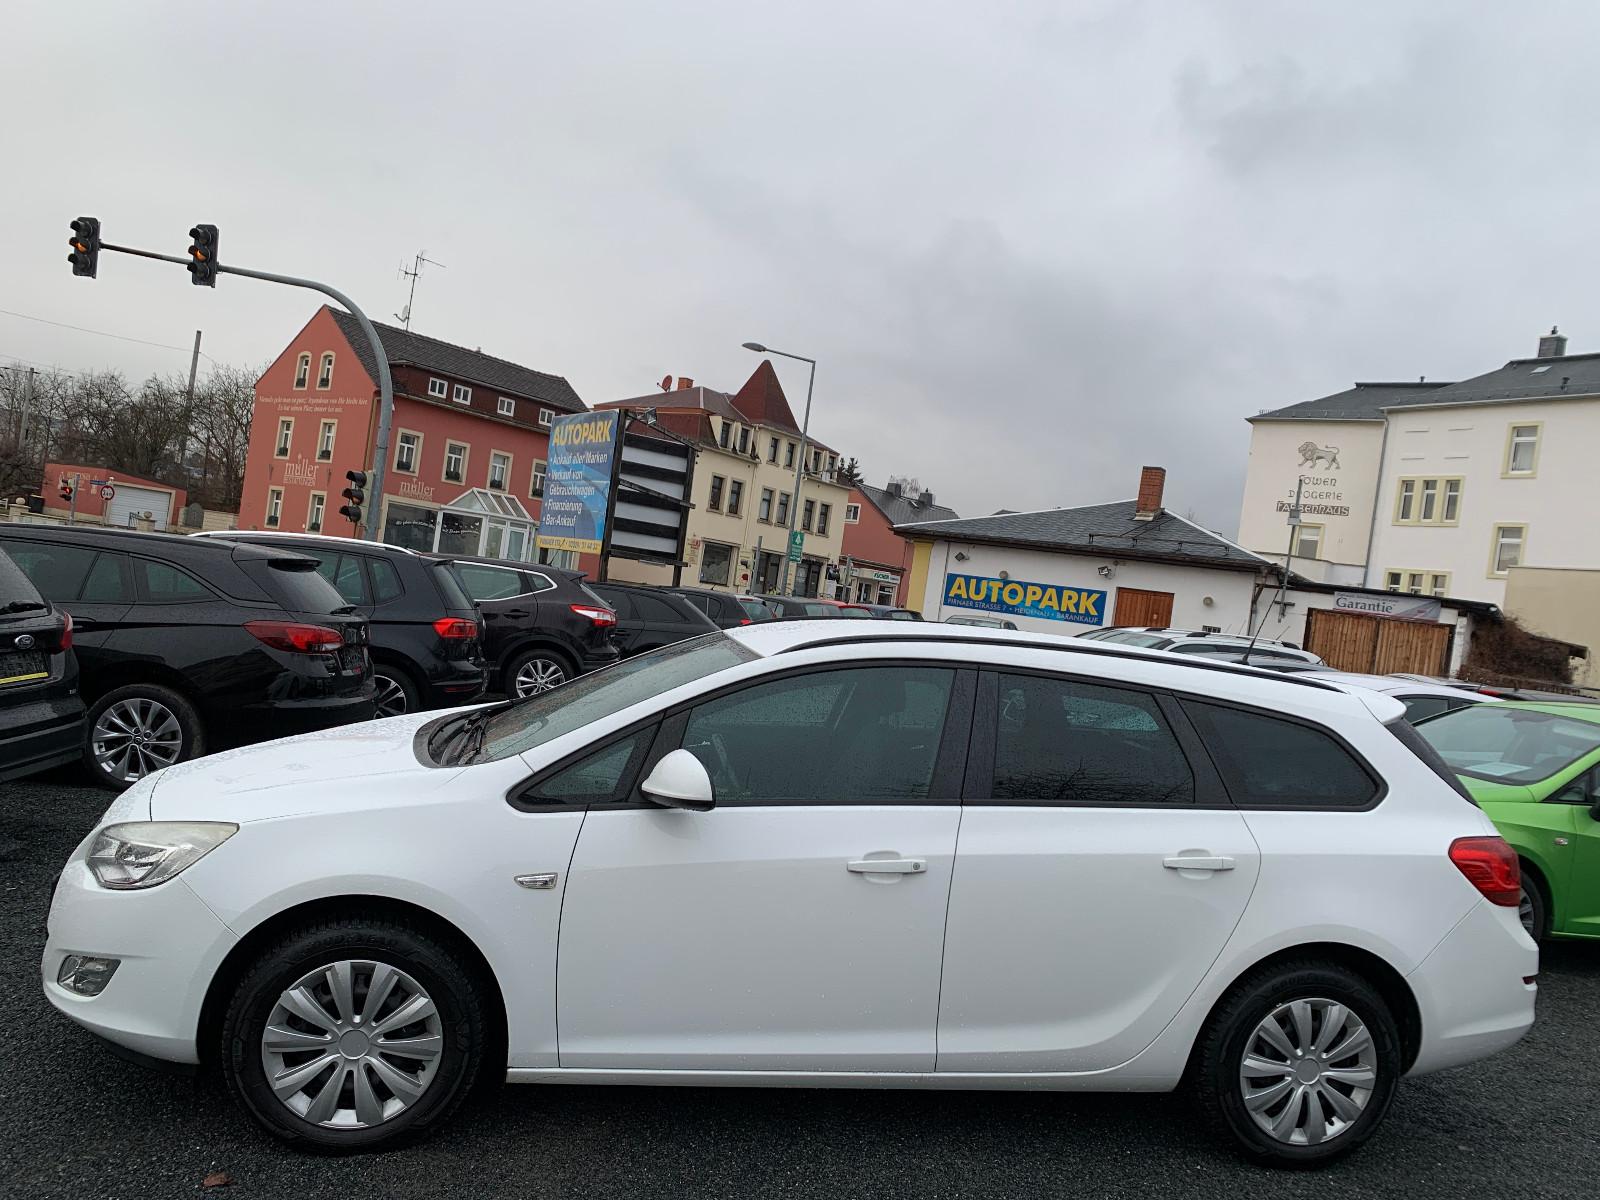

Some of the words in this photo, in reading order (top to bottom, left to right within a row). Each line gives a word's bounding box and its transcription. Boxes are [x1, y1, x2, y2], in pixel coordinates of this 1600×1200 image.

[553, 419, 612, 447] AUTOPARK
[585, 450, 608, 464] Marken
[549, 484, 595, 499] Gebrauchtwagen
[1288, 489, 1343, 501] DOGERIE
[547, 498, 583, 515] Finanzierung
[545, 514, 576, 527] Bar-Ankauf
[949, 576, 1100, 616] AUTOPARK
[947, 598, 974, 607] PIRNAER
[974, 601, 1001, 611] STRASSE
[1056, 612, 1099, 624] BARANKAUF
[1335, 597, 1393, 614] Garantie
